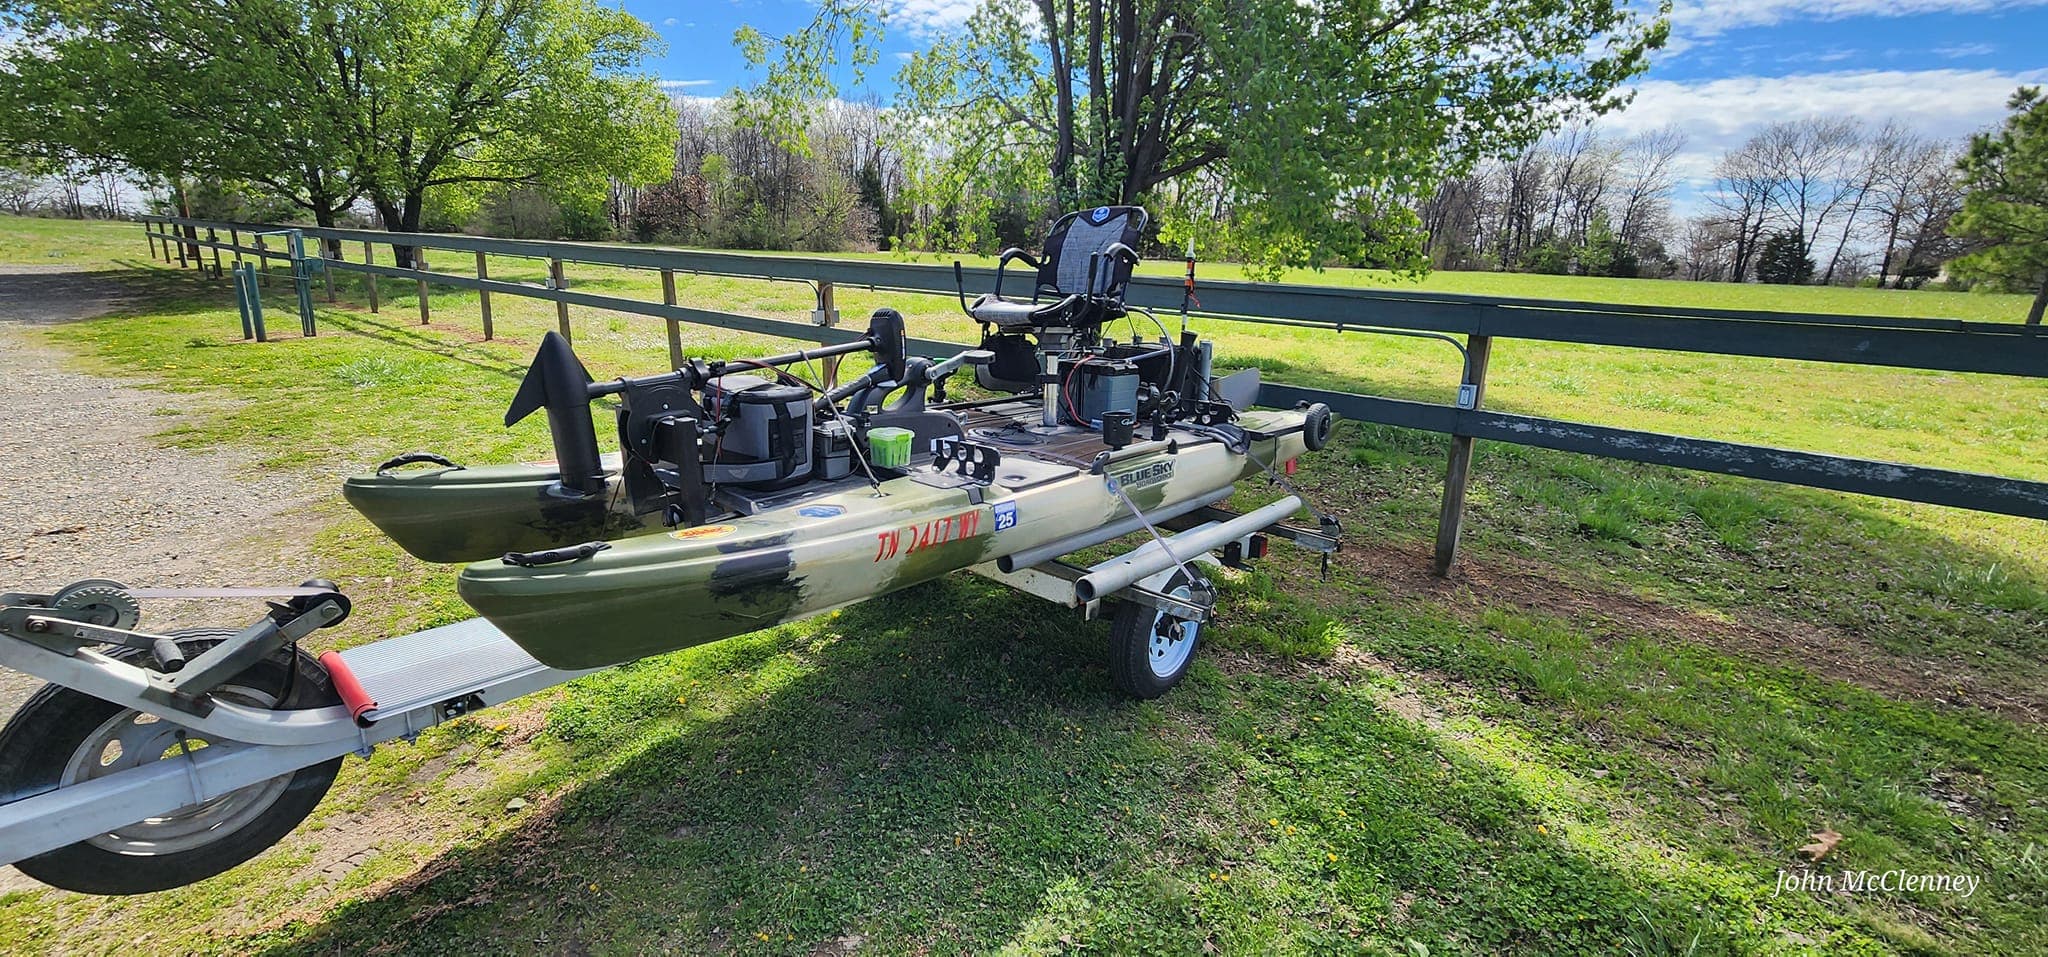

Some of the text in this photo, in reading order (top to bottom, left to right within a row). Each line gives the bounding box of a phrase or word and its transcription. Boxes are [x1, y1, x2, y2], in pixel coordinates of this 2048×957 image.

[1120, 468, 1151, 487] BLUE
[1152, 461, 1175, 477] SKY
[998, 512, 1014, 530] 25
[874, 508, 981, 563] TN 2417 WY
